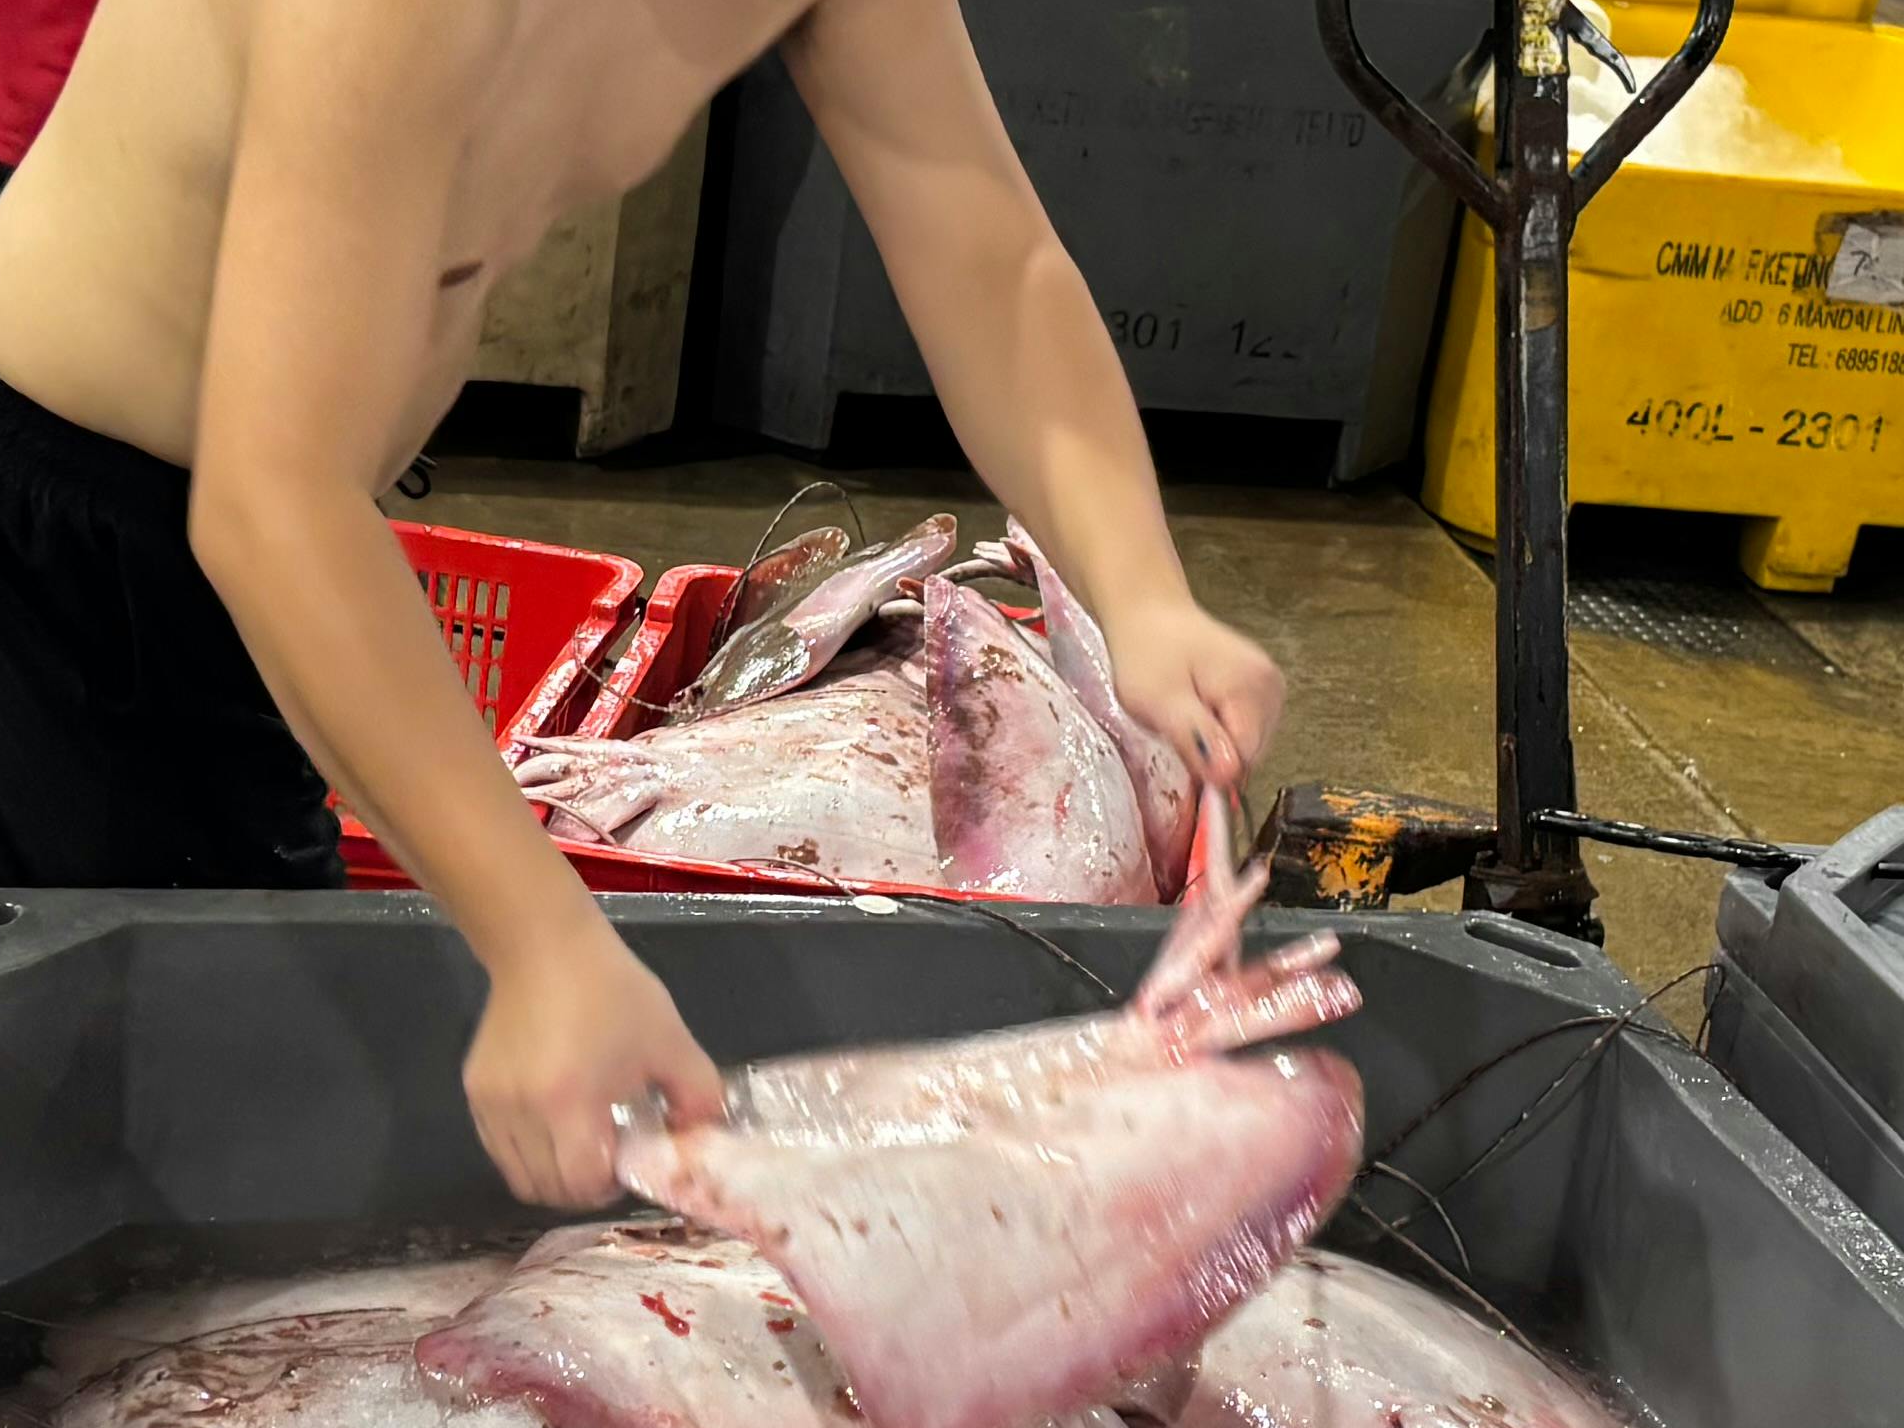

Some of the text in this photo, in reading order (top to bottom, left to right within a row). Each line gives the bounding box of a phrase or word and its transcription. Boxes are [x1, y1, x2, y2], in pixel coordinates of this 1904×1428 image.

[1656, 240, 1712, 280] CMM
[1793, 300, 1871, 334] MANDAI
[1787, 342, 1819, 369] TEL
